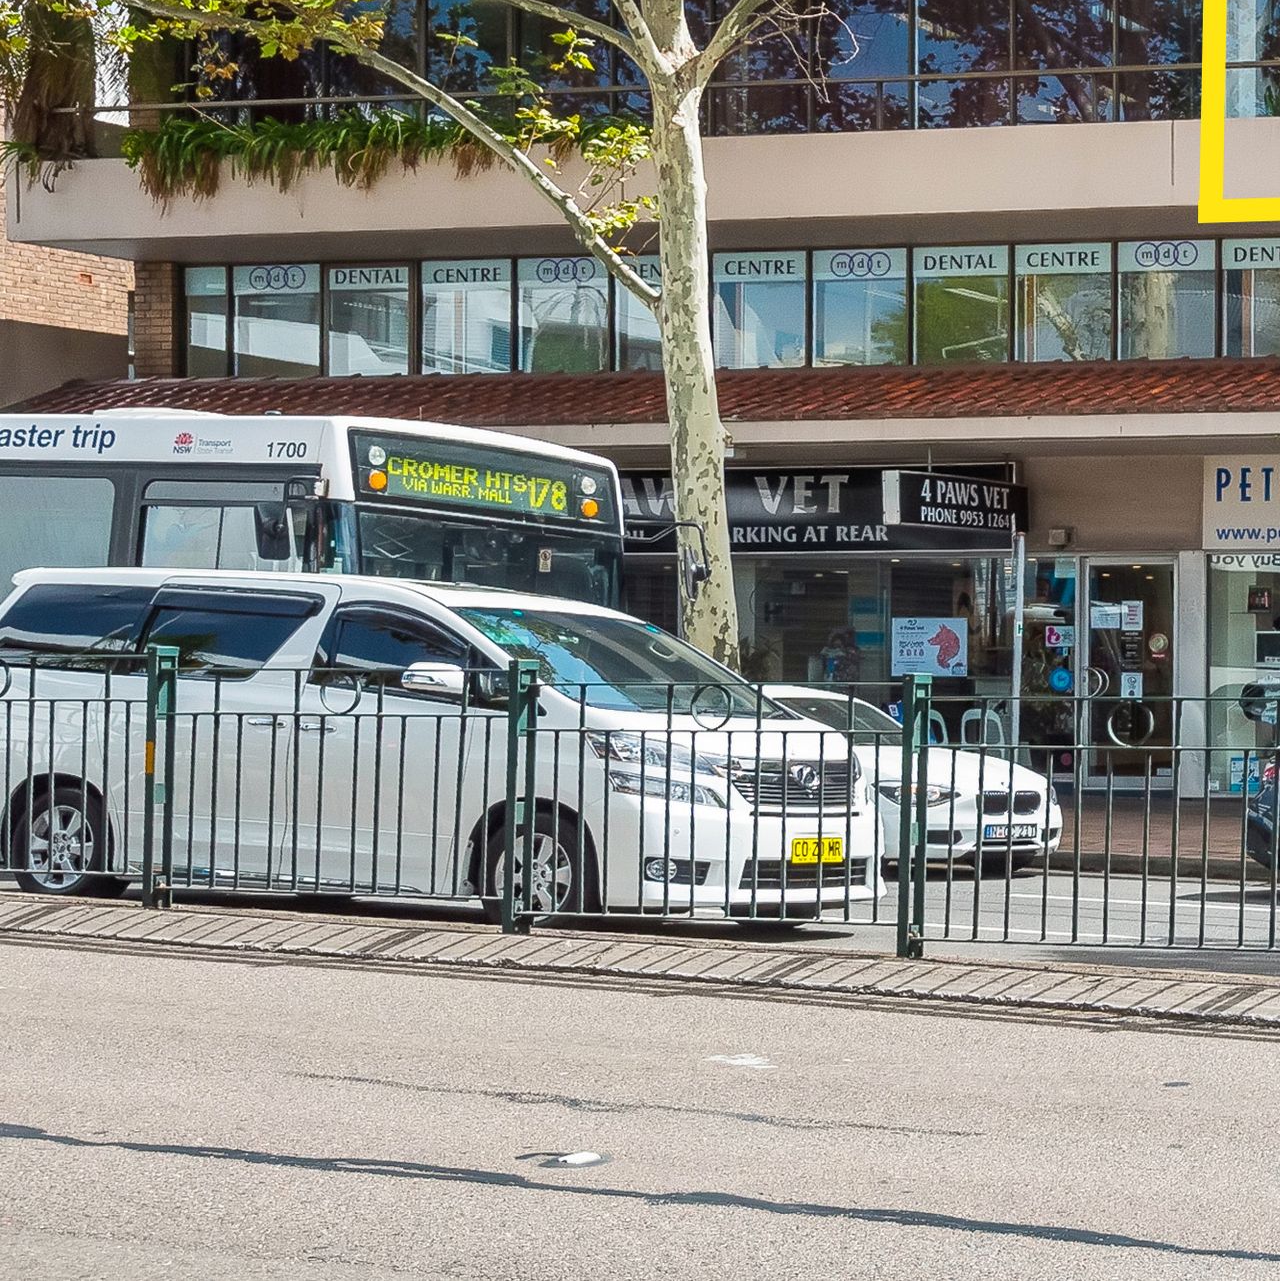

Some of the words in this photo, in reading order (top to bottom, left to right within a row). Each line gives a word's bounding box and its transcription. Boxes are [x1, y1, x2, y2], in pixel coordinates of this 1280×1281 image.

[724, 259, 796, 275] CENTRE
[923, 253, 998, 270] DENTAL
[1026, 250, 1100, 268] CENTRE
[335, 268, 404, 285] DENTAL
[433, 266, 502, 283] CENTRE
[71, 423, 116, 454] trip
[173, 446, 193, 455] NSW
[198, 438, 232, 449] Transport
[266, 442, 307, 458] 1700
[387, 456, 478, 486] CROMER
[485, 470, 527, 493] HTS
[403, 475, 428, 492] VIA
[478, 488, 513, 504] MALL
[527, 476, 567, 511] 178
[755, 475, 850, 515] VET
[920, 479, 931, 500] 4
[936, 480, 979, 508] PAWS
[984, 486, 1010, 510] VET
[920, 506, 957, 526] PHONE
[960, 510, 985, 527] 9953
[987, 513, 1010, 529] 1264
[731, 526, 797, 543] RKING
[803, 526, 829, 542] AT
[836, 525, 889, 542] REAR
